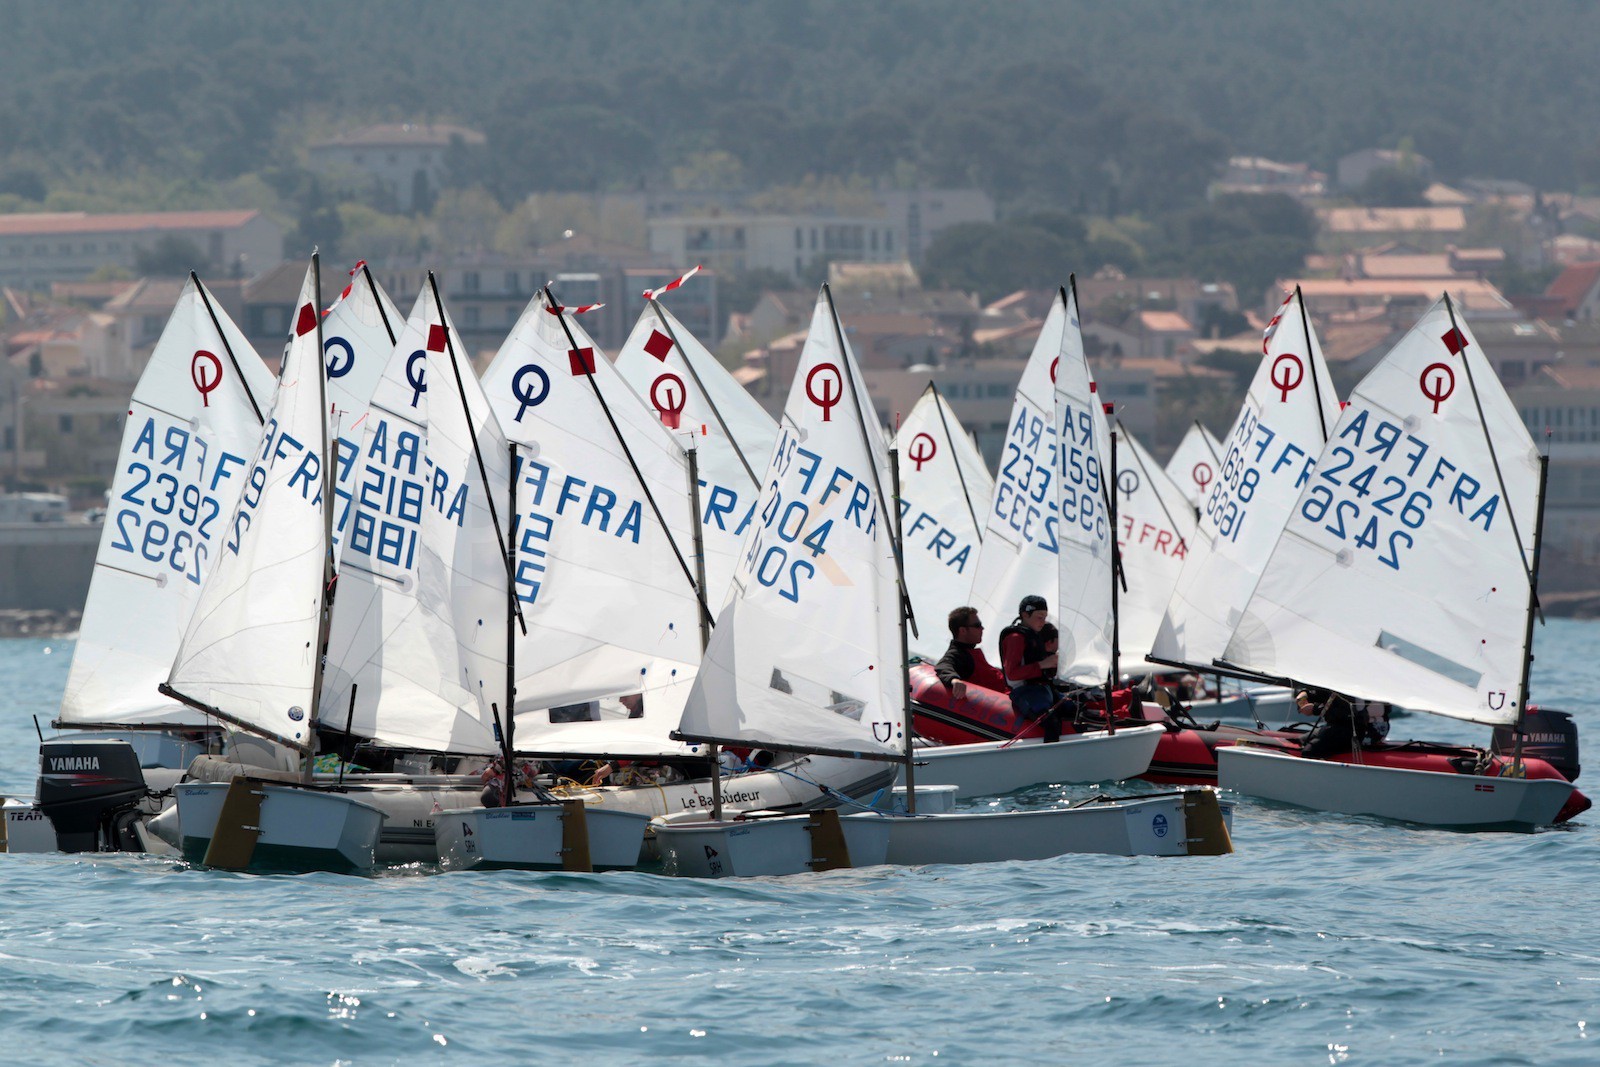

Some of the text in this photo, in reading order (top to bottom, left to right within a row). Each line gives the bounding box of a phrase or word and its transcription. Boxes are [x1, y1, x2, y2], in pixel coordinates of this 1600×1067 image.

[360, 465, 424, 525] 218
[1003, 442, 1058, 511] 233
[1062, 443, 1099, 494] 159
[1320, 447, 1432, 529] 2426
[1427, 456, 1500, 532] FRA
[121, 462, 220, 540] 2392
[555, 475, 642, 545] FRA
[907, 512, 972, 575] FRA
[1138, 522, 1186, 561] FRA
[50, 756, 100, 771] YAMAHA
[1529, 733, 1566, 744] YAMAHA
[681, 791, 760, 809] Le Baoudeur
